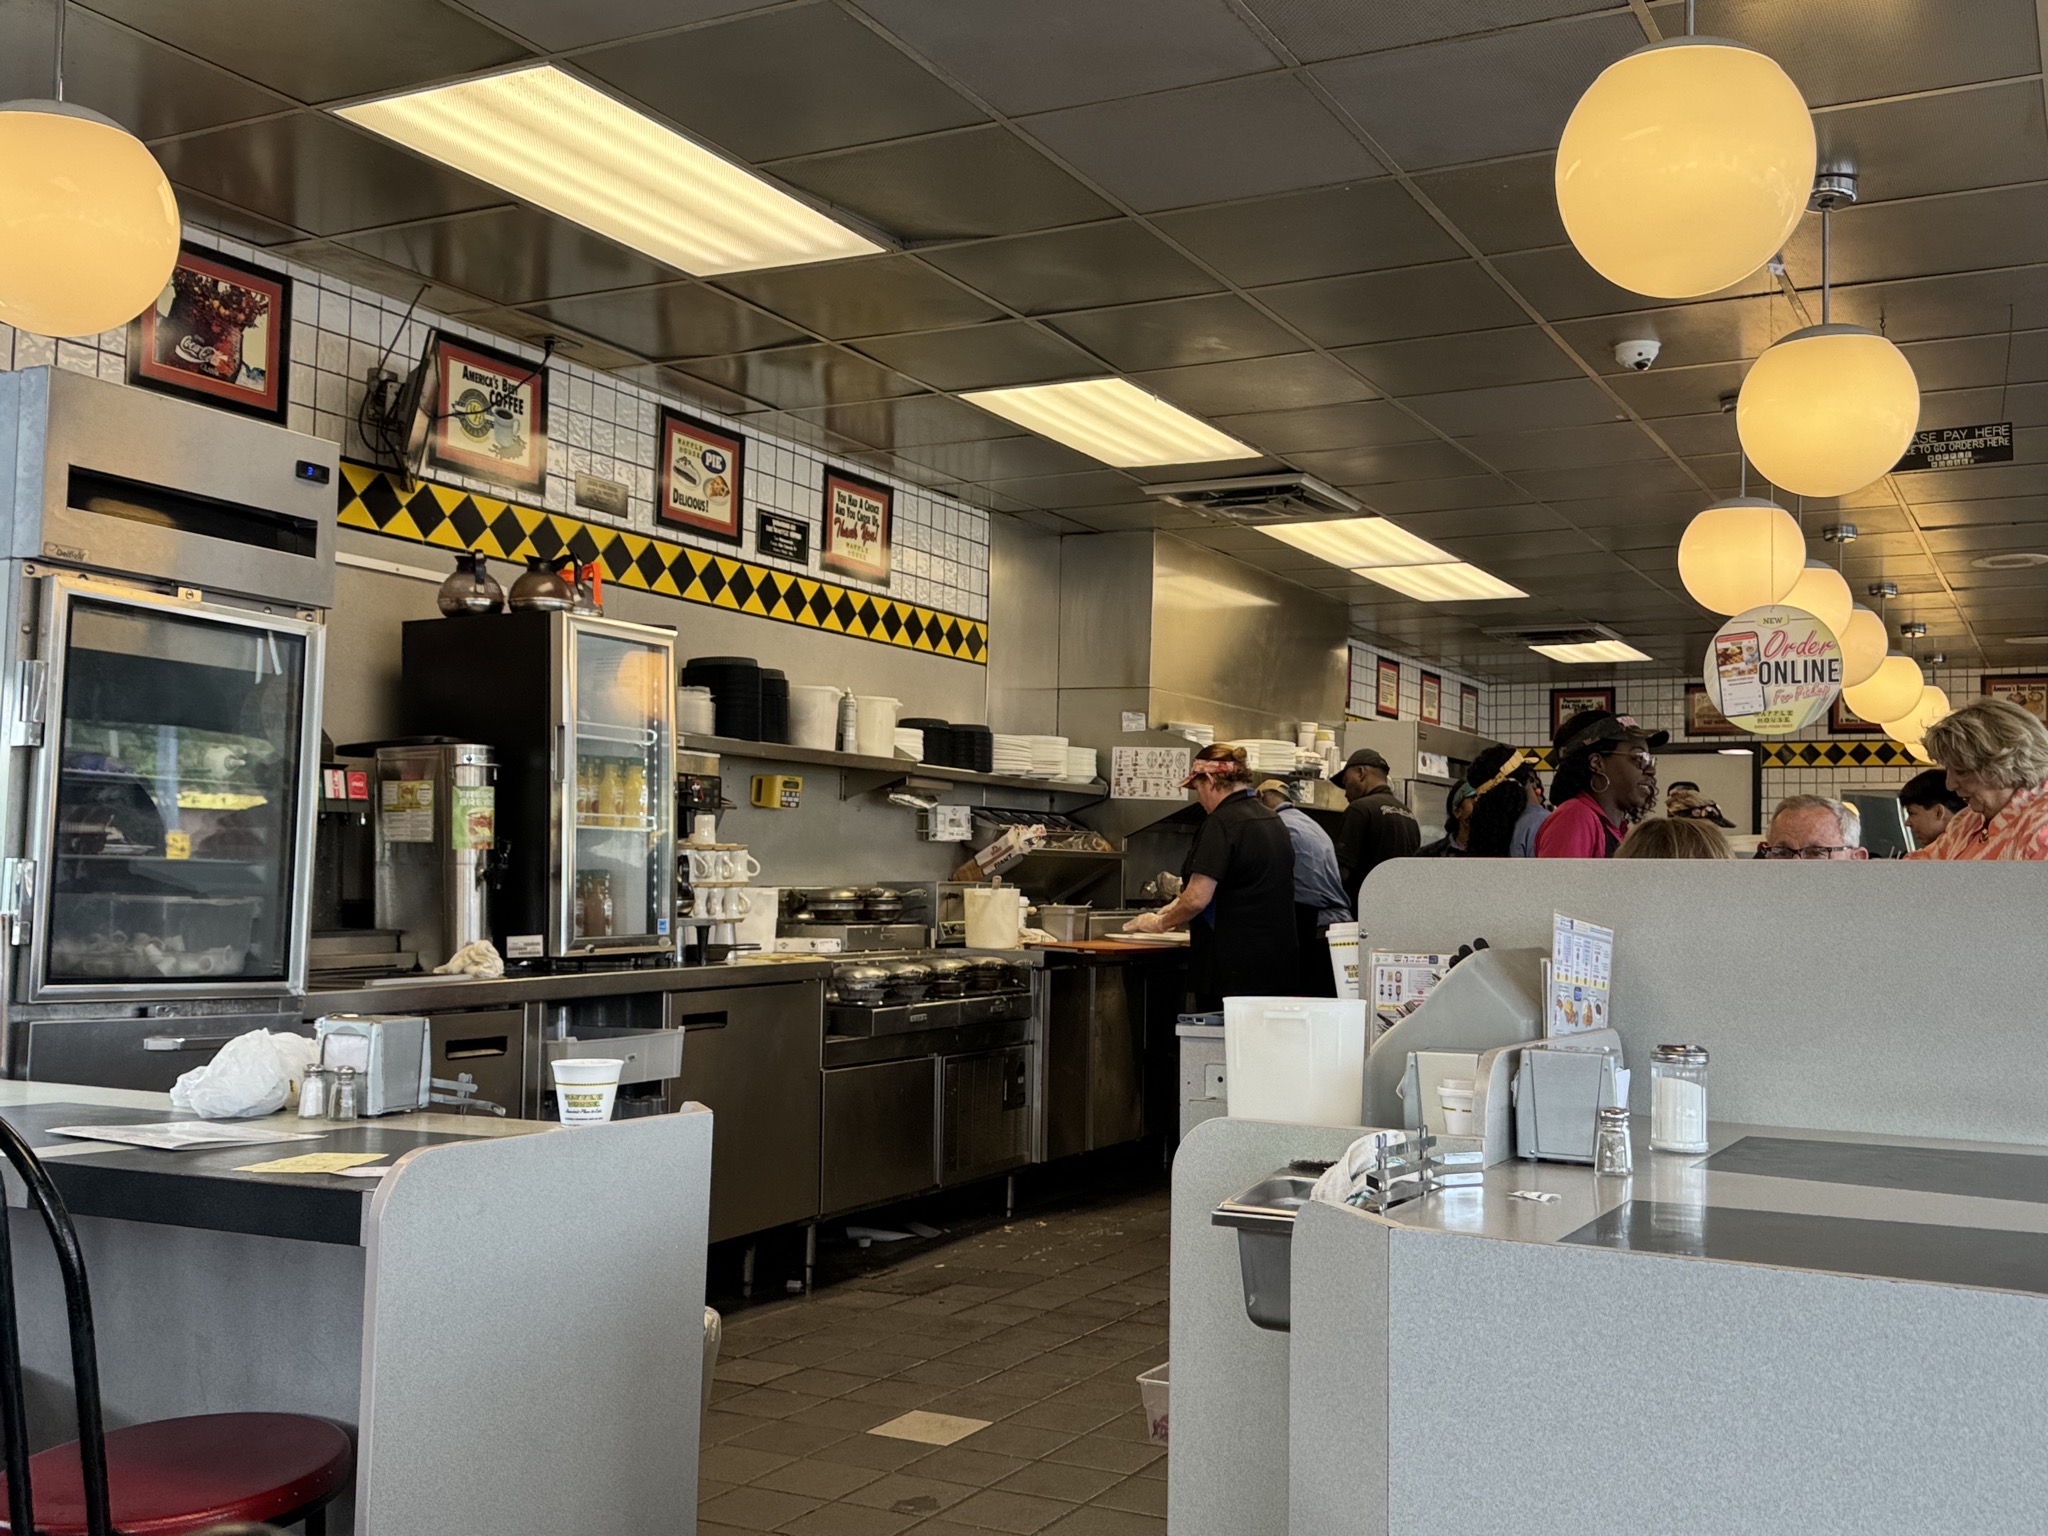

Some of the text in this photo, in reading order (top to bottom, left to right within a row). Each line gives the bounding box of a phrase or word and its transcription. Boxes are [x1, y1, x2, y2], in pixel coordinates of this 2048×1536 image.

[1943, 428, 1968, 441] PAY
[1974, 424, 2010, 438] HERE
[1920, 445, 1931, 454] TO
[1934, 443, 1946, 453] GO
[1949, 439, 1984, 451] ORDERS
[1987, 436, 2010, 448] HERE
[705, 452, 723, 470] PIE
[859, 498, 863, 509] A
[834, 517, 858, 540] Thank
[1763, 617, 1783, 625] NEW
[1764, 629, 1835, 660] Order
[1758, 658, 1840, 685] ONLINE
[1772, 683, 1831, 706] For Pickup
